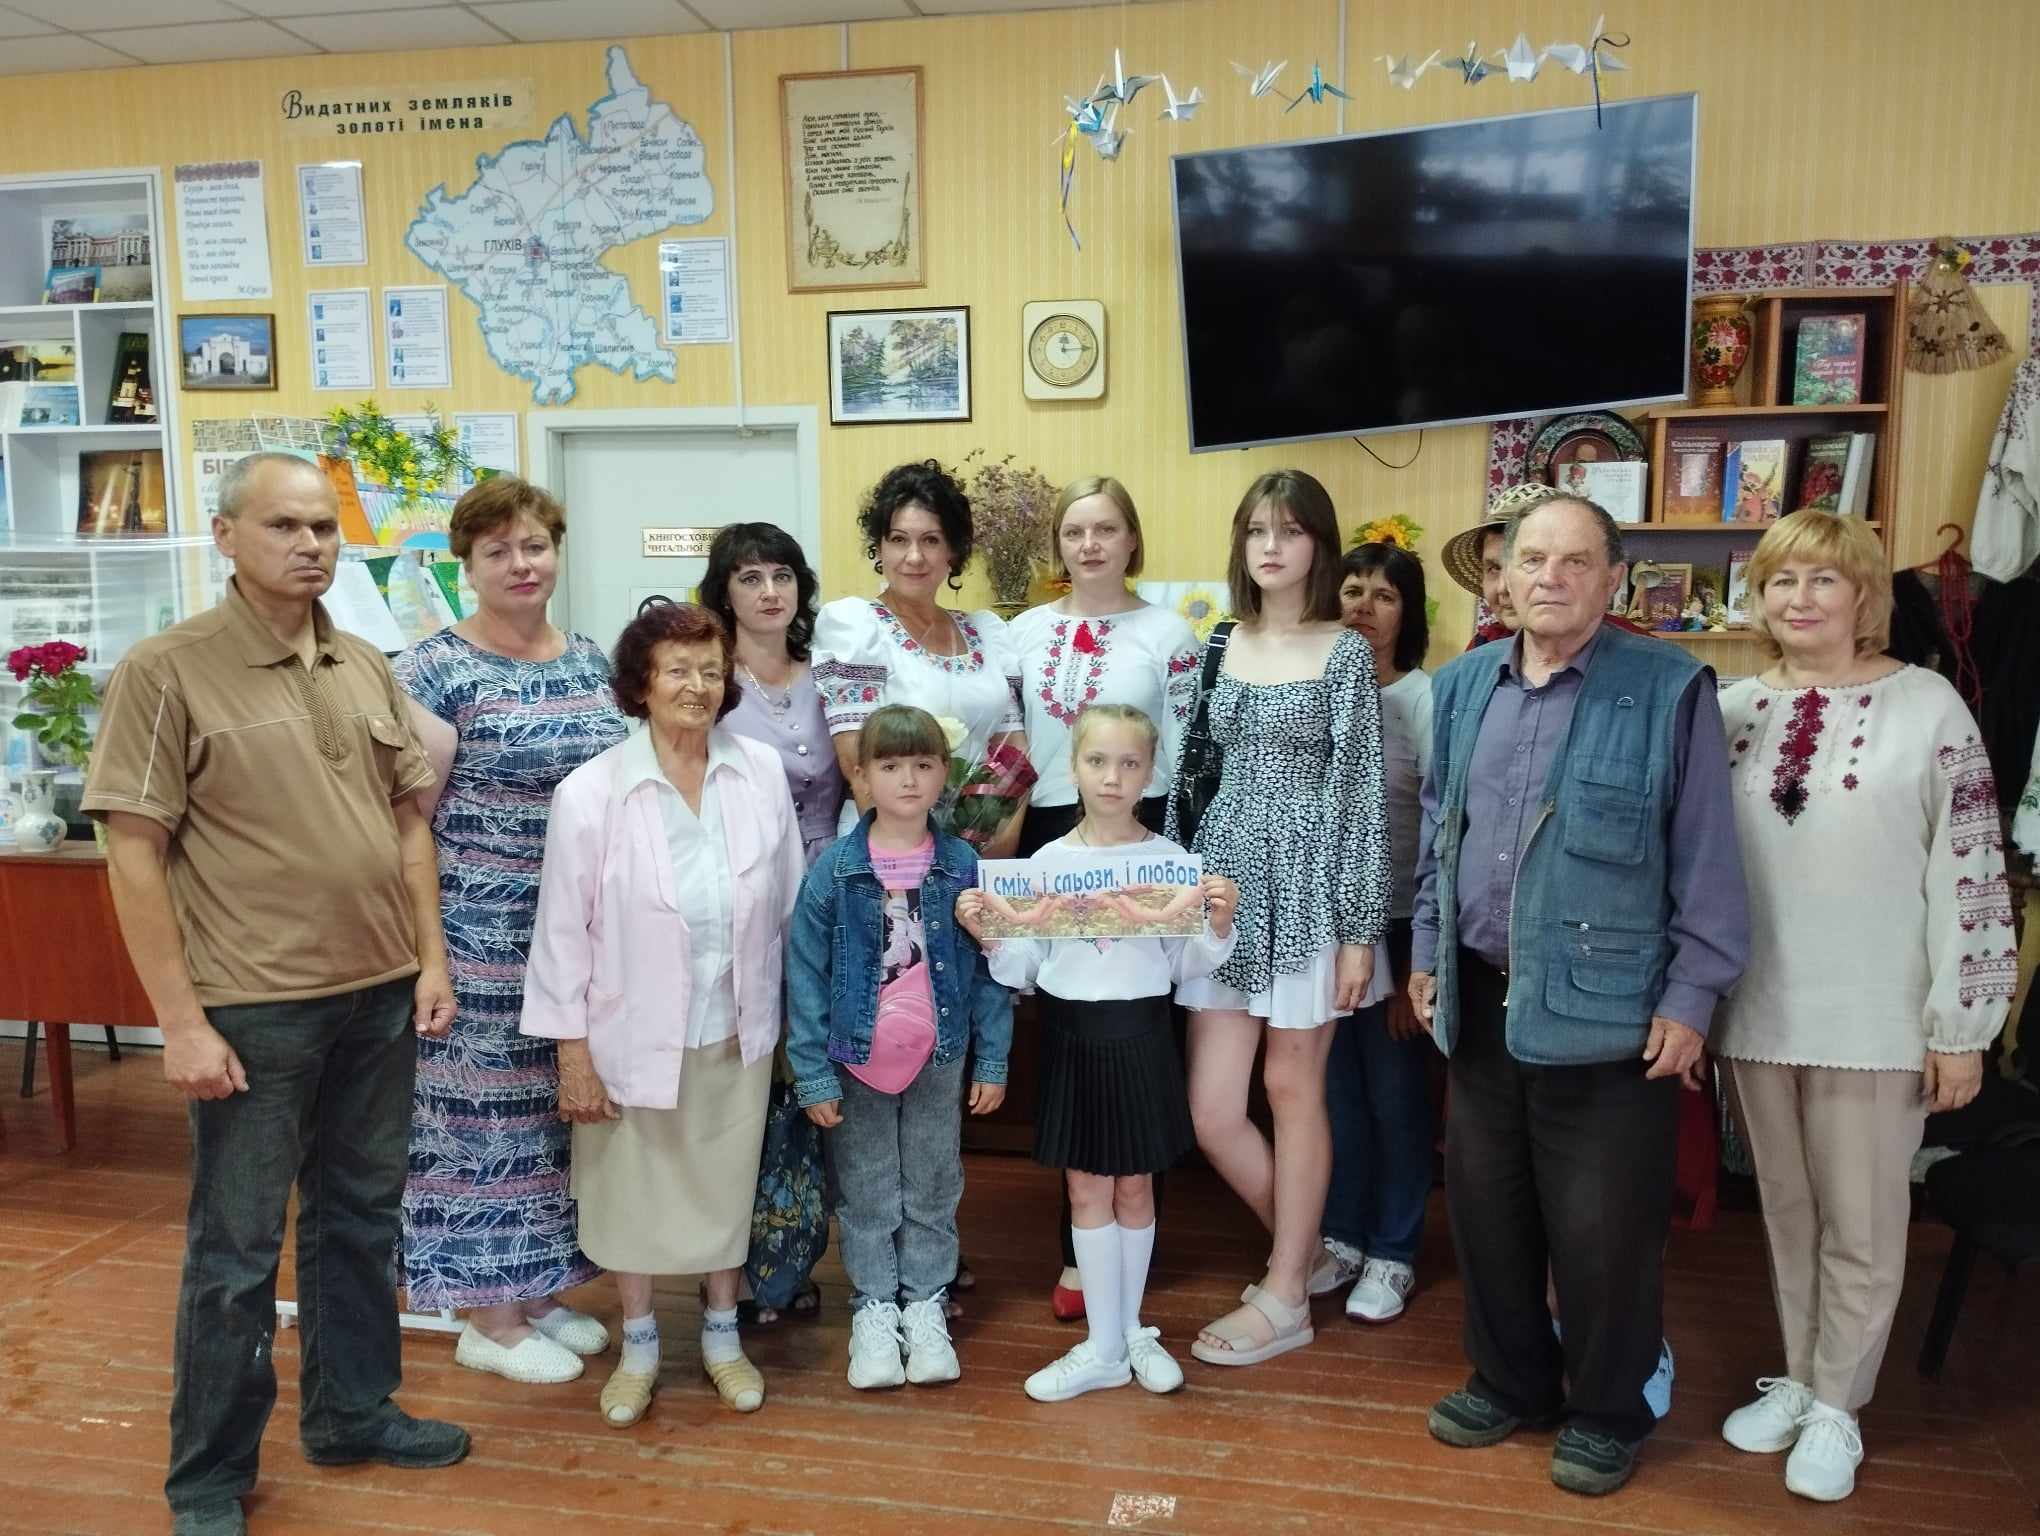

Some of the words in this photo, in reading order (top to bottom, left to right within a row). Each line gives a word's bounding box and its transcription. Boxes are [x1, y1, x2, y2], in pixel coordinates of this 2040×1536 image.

[282, 89, 392, 119] Видатних
[408, 93, 513, 112] земляків
[336, 118, 404, 134] золоті
[420, 115, 484, 131] імена
[484, 238, 522, 252] ГЛУХІВ
[1054, 868, 1119, 894] сльози,
[1137, 860, 1198, 887] любов
